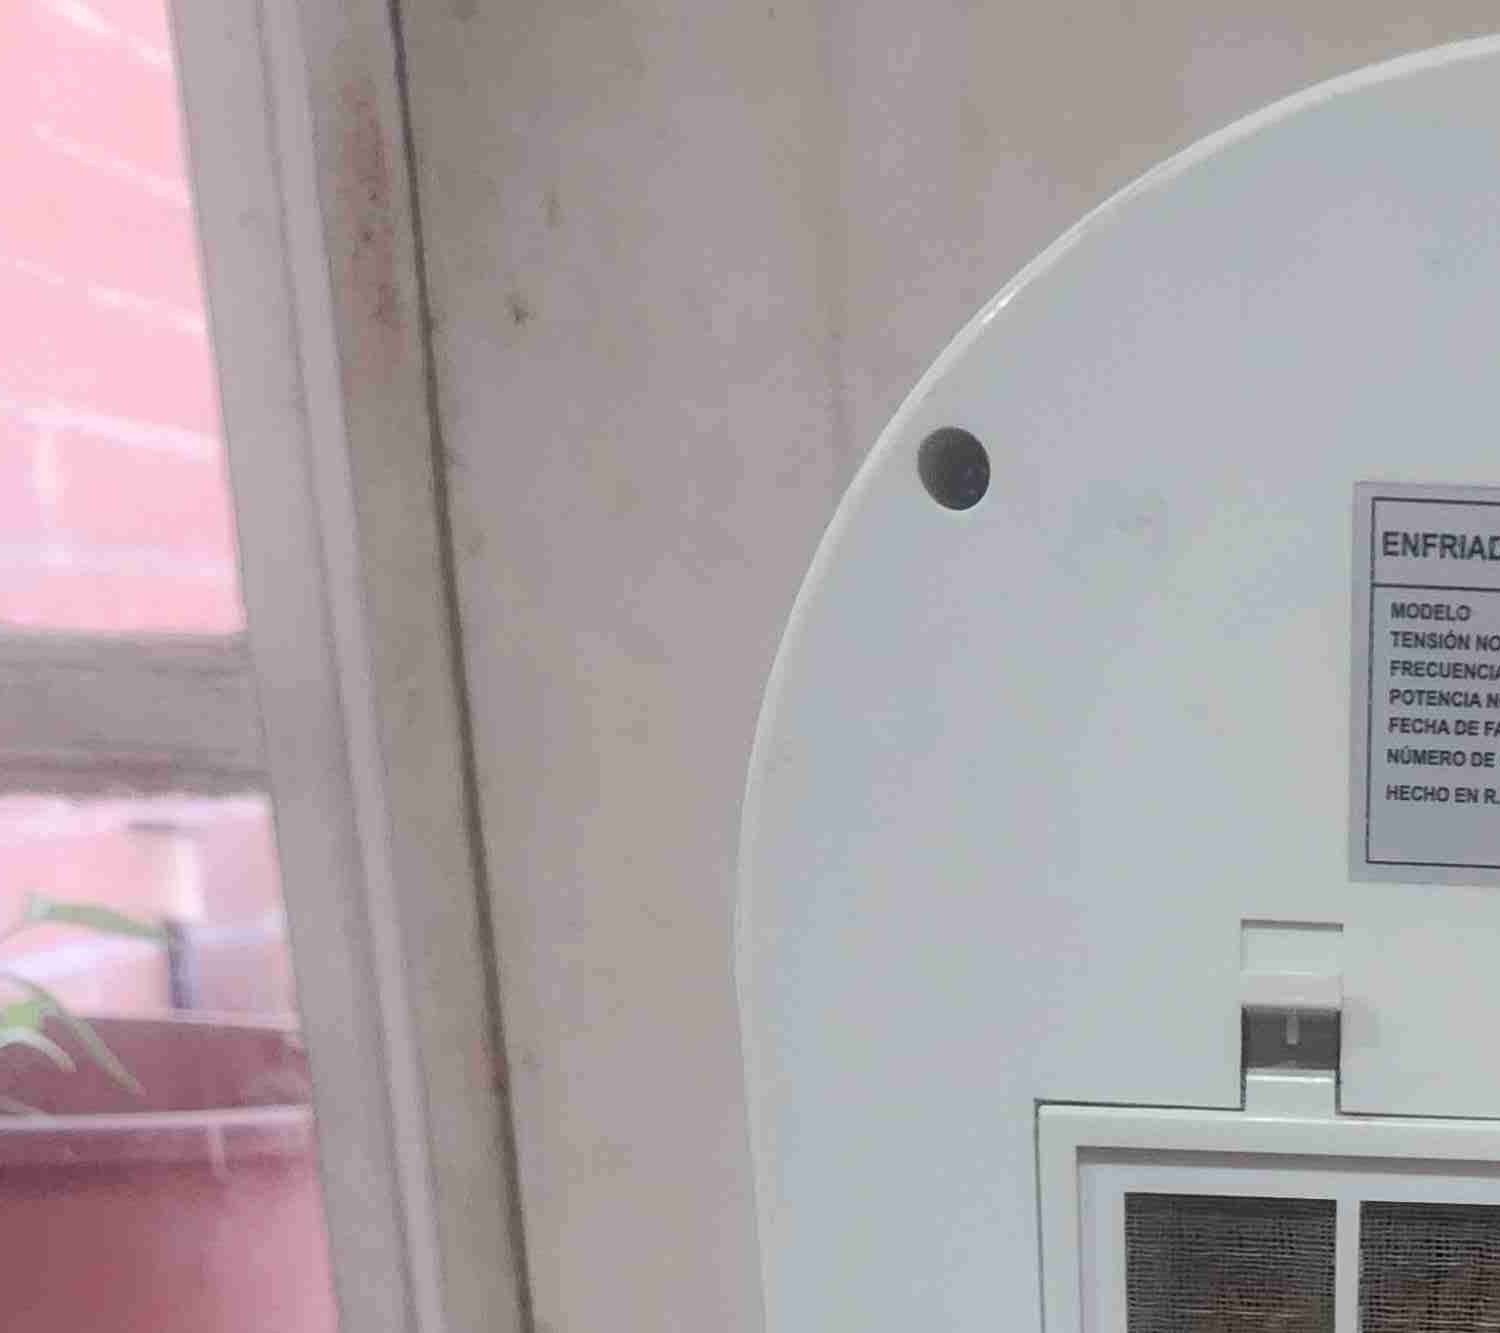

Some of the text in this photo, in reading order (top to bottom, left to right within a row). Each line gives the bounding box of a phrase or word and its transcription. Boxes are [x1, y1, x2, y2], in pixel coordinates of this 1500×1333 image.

[1390, 602, 1472, 622] MODELO
[1390, 629, 1471, 651] TENSIÓN
[1389, 689, 1482, 709] POTENCIA
[1388, 717, 1450, 736] FECHA
[1454, 719, 1481, 737] DE
[1387, 745, 1467, 768] NÚMERO
[1471, 751, 1496, 768] DE
[1386, 784, 1450, 803] HECHO
[1454, 787, 1479, 804] EN
